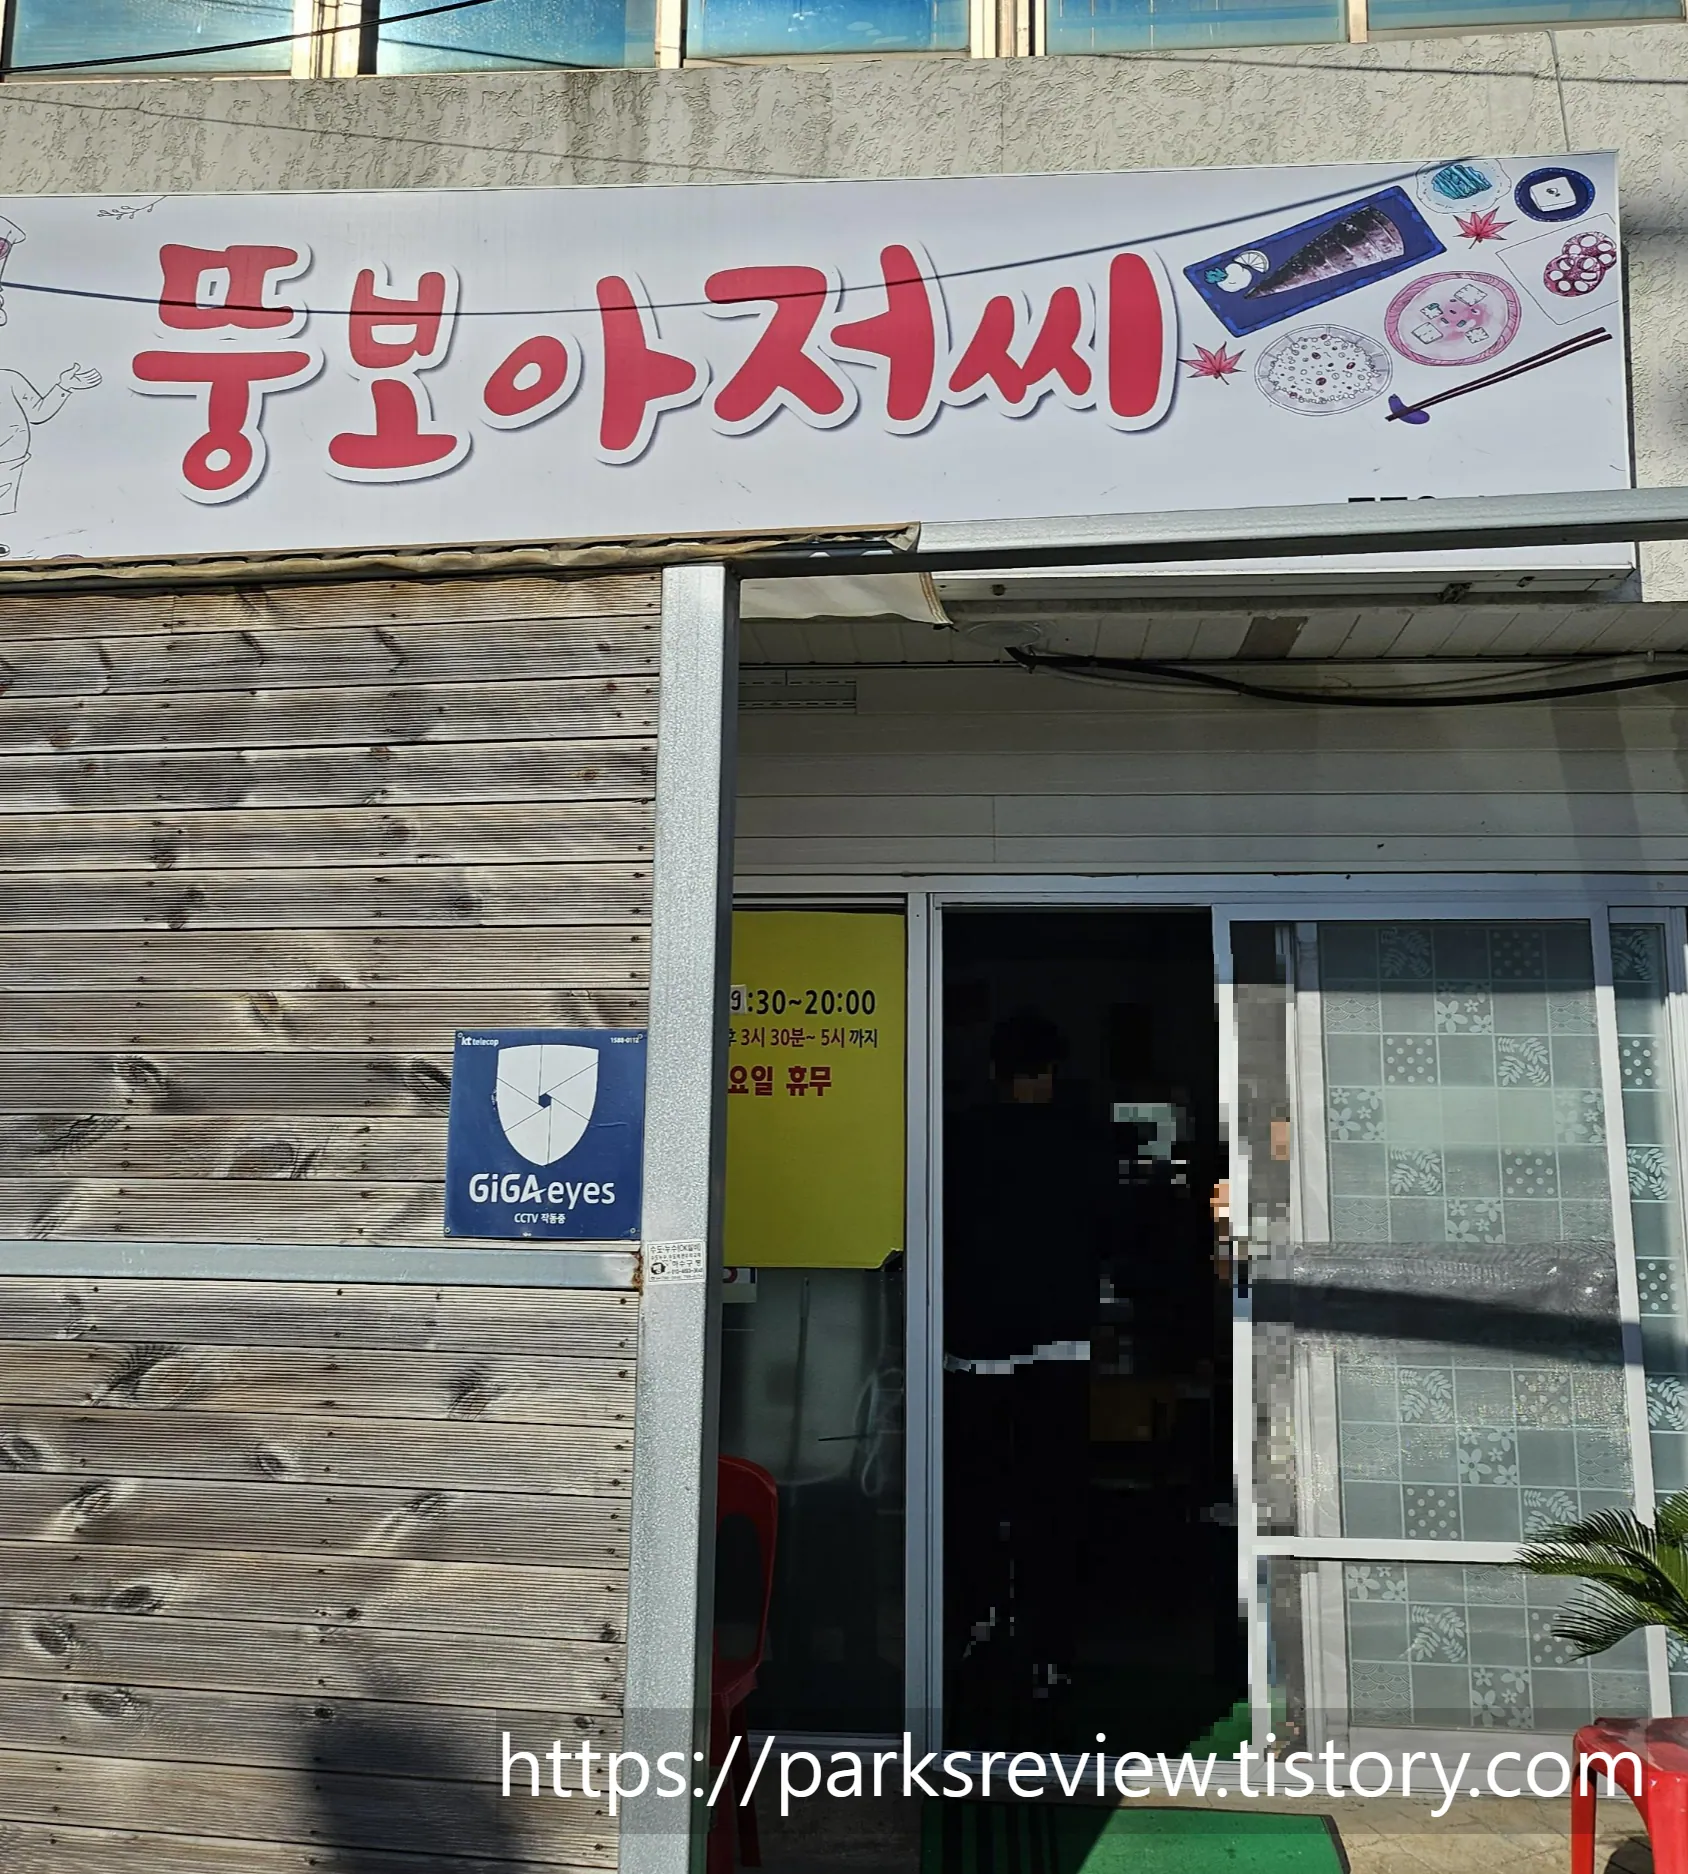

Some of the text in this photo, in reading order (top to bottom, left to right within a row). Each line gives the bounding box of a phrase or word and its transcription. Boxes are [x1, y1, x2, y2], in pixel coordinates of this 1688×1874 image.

[132, 243, 1164, 492] 뚱보아저씨
[472, 1037, 499, 1047] telecop
[728, 1065, 832, 1097] 요일 휴무
[548, 1181, 616, 1210] eyes
[514, 1213, 566, 1224] CCTV 작동중
